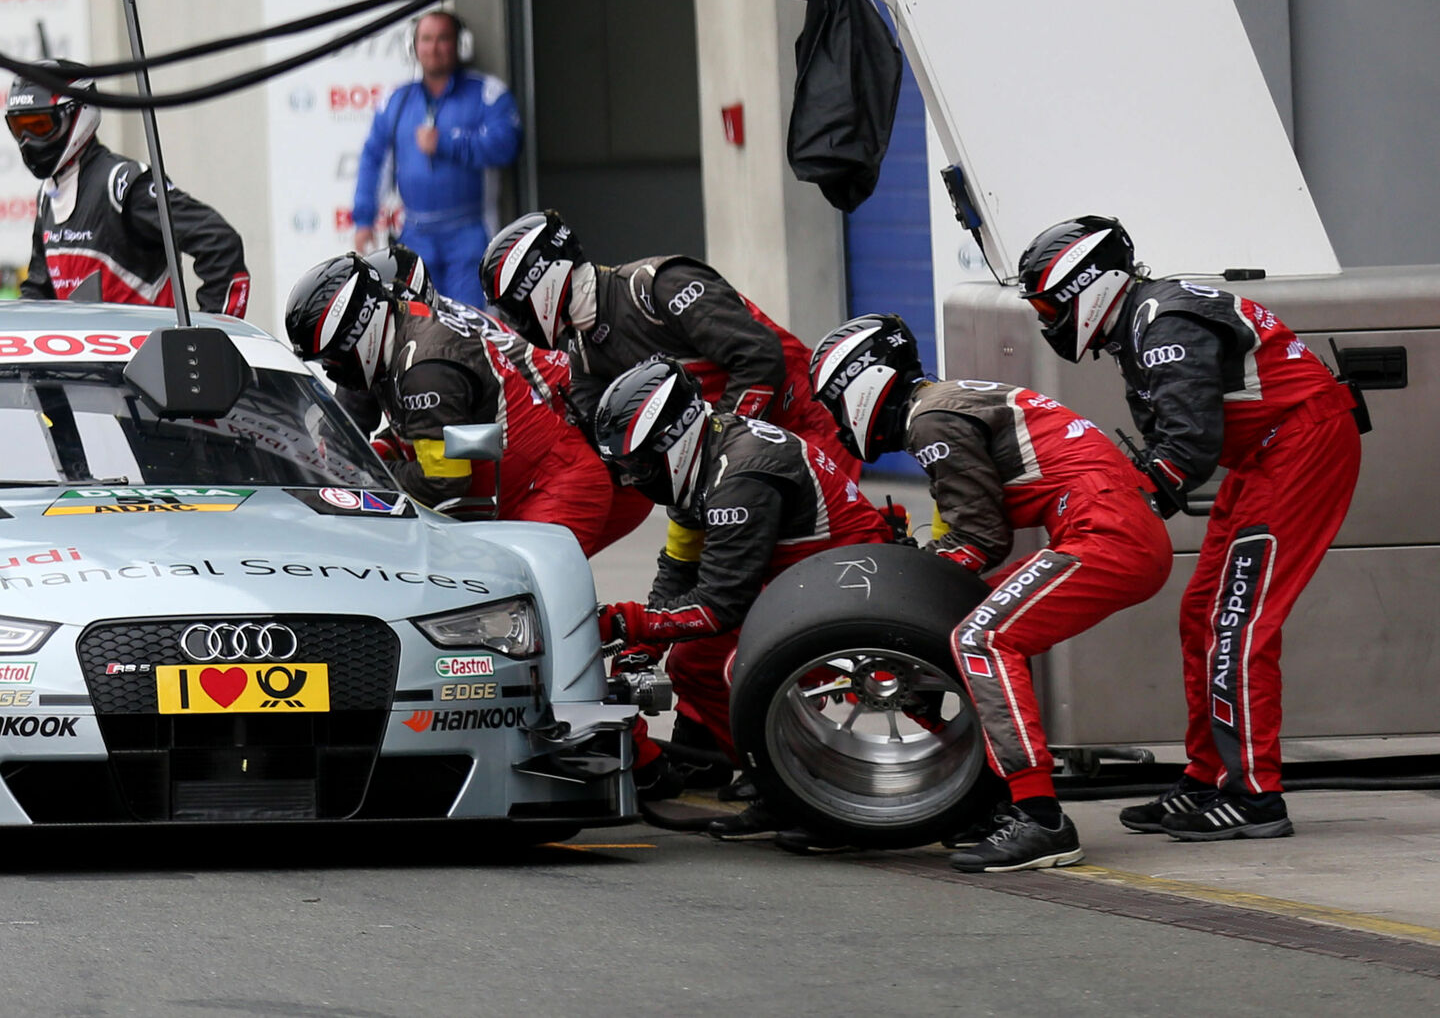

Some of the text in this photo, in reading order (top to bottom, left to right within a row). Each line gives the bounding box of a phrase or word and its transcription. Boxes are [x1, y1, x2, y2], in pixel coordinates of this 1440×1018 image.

[9, 93, 35, 106] uvex
[551, 225, 572, 248] uve
[513, 256, 551, 302] uvex
[1055, 263, 1103, 303] uvex
[340, 294, 378, 352] uvex
[825, 350, 878, 400] uvex
[654, 393, 703, 453] uvex
[76, 489, 243, 498] DEKRA
[95, 503, 201, 514] ADAC
[241, 559, 493, 595] Services
[992, 558, 1054, 605] Sport
[1215, 556, 1252, 690] Audi Sport
[450, 657, 493, 675] Castrol
[179, 669, 188, 709] I
[440, 683, 497, 701] EDGE
